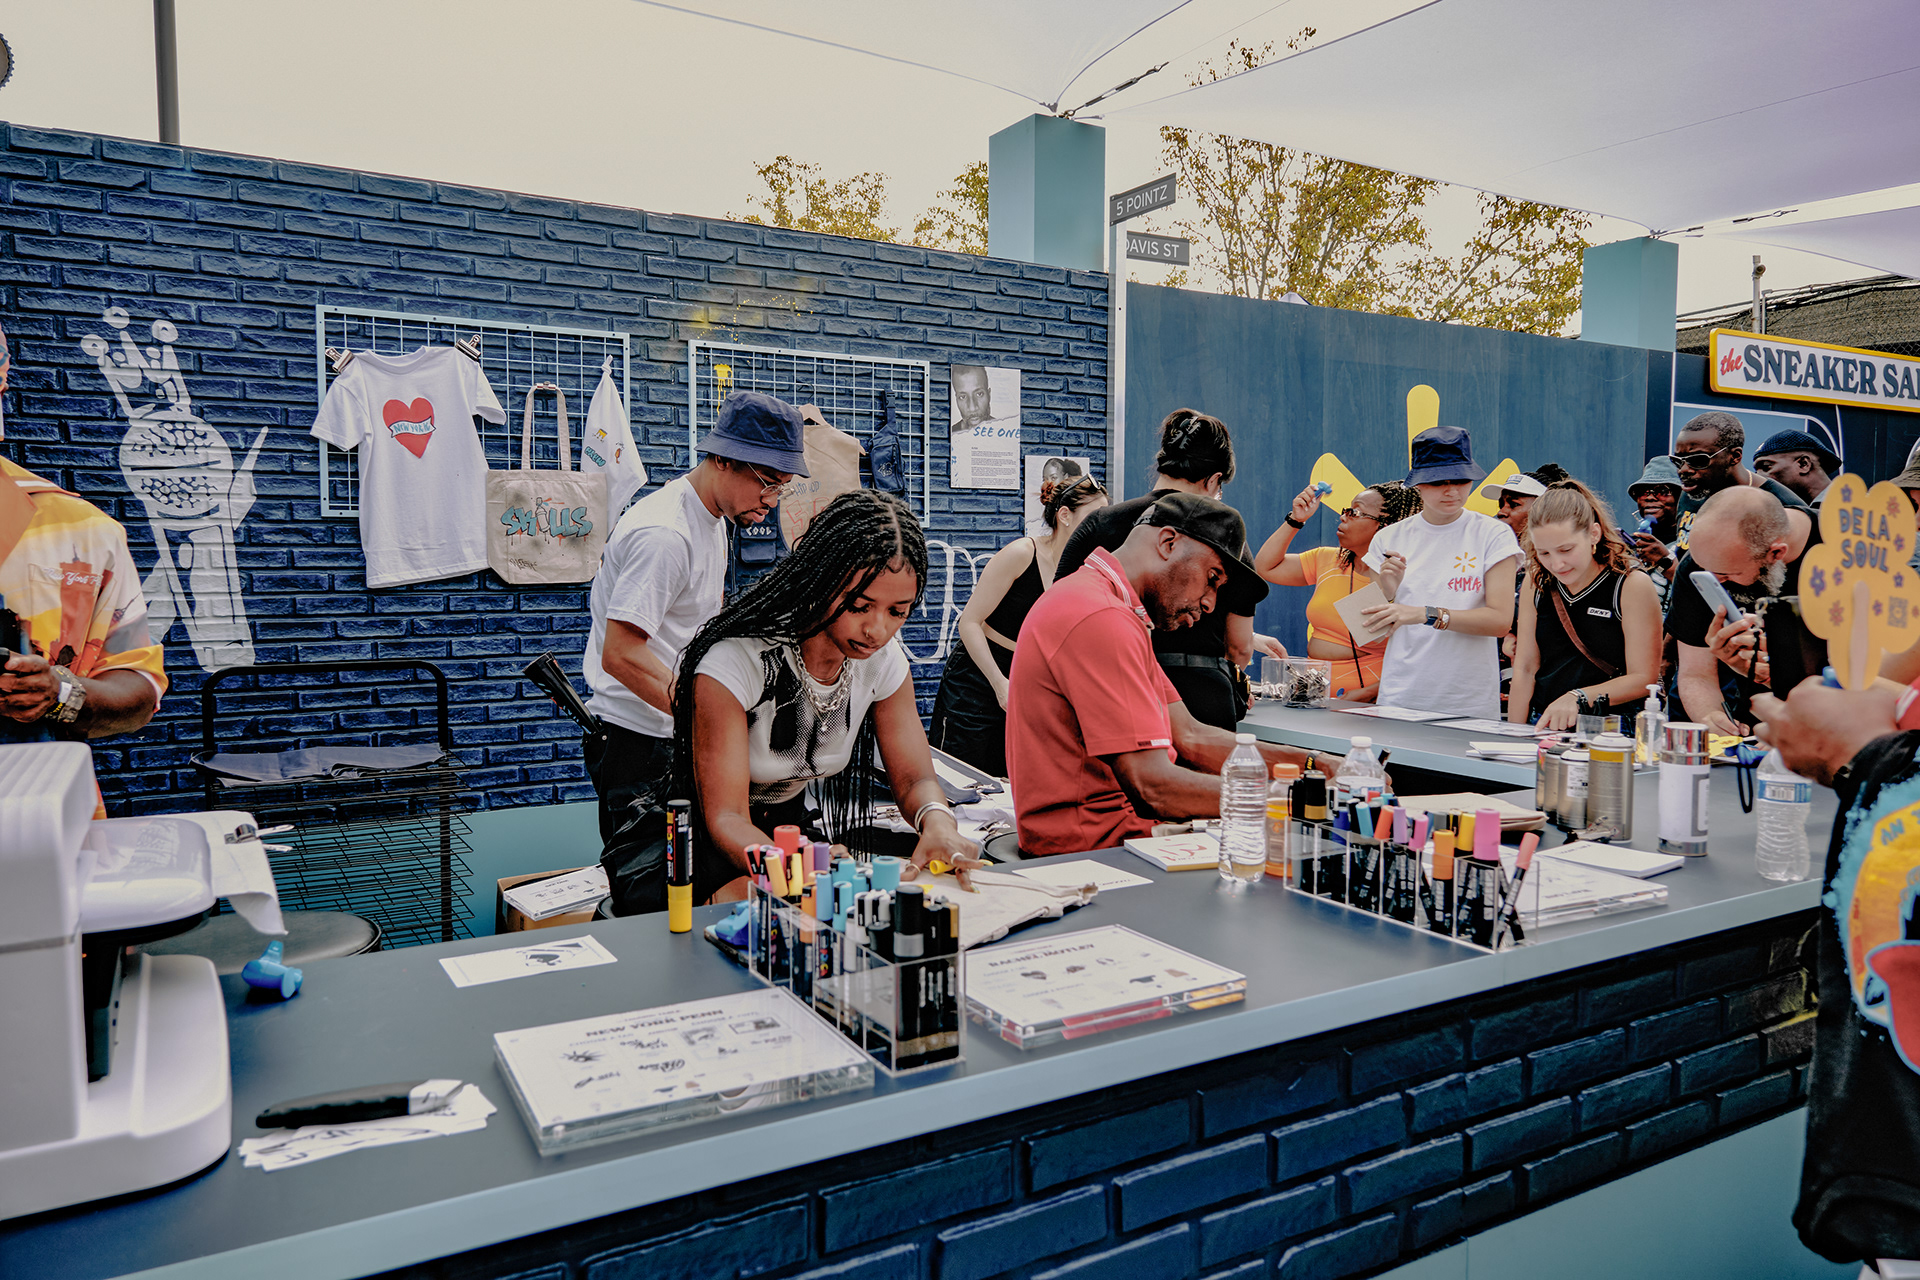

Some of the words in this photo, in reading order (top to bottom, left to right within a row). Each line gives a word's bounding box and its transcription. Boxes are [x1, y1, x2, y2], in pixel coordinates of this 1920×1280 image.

[1116, 201, 1123, 216] 5
[1126, 184, 1168, 213] POINTZ
[1163, 243, 1179, 258] ST
[1720, 347, 1743, 376] the
[1743, 344, 1878, 396] SNEAKER
[973, 426, 994, 437] SEE
[1838, 506, 1864, 535] DE
[1867, 510, 1890, 541] LA
[1841, 538, 1889, 573] SOUL
[1447, 576, 1482, 593] EMMA
[1589, 608, 1610, 616] DKNY
